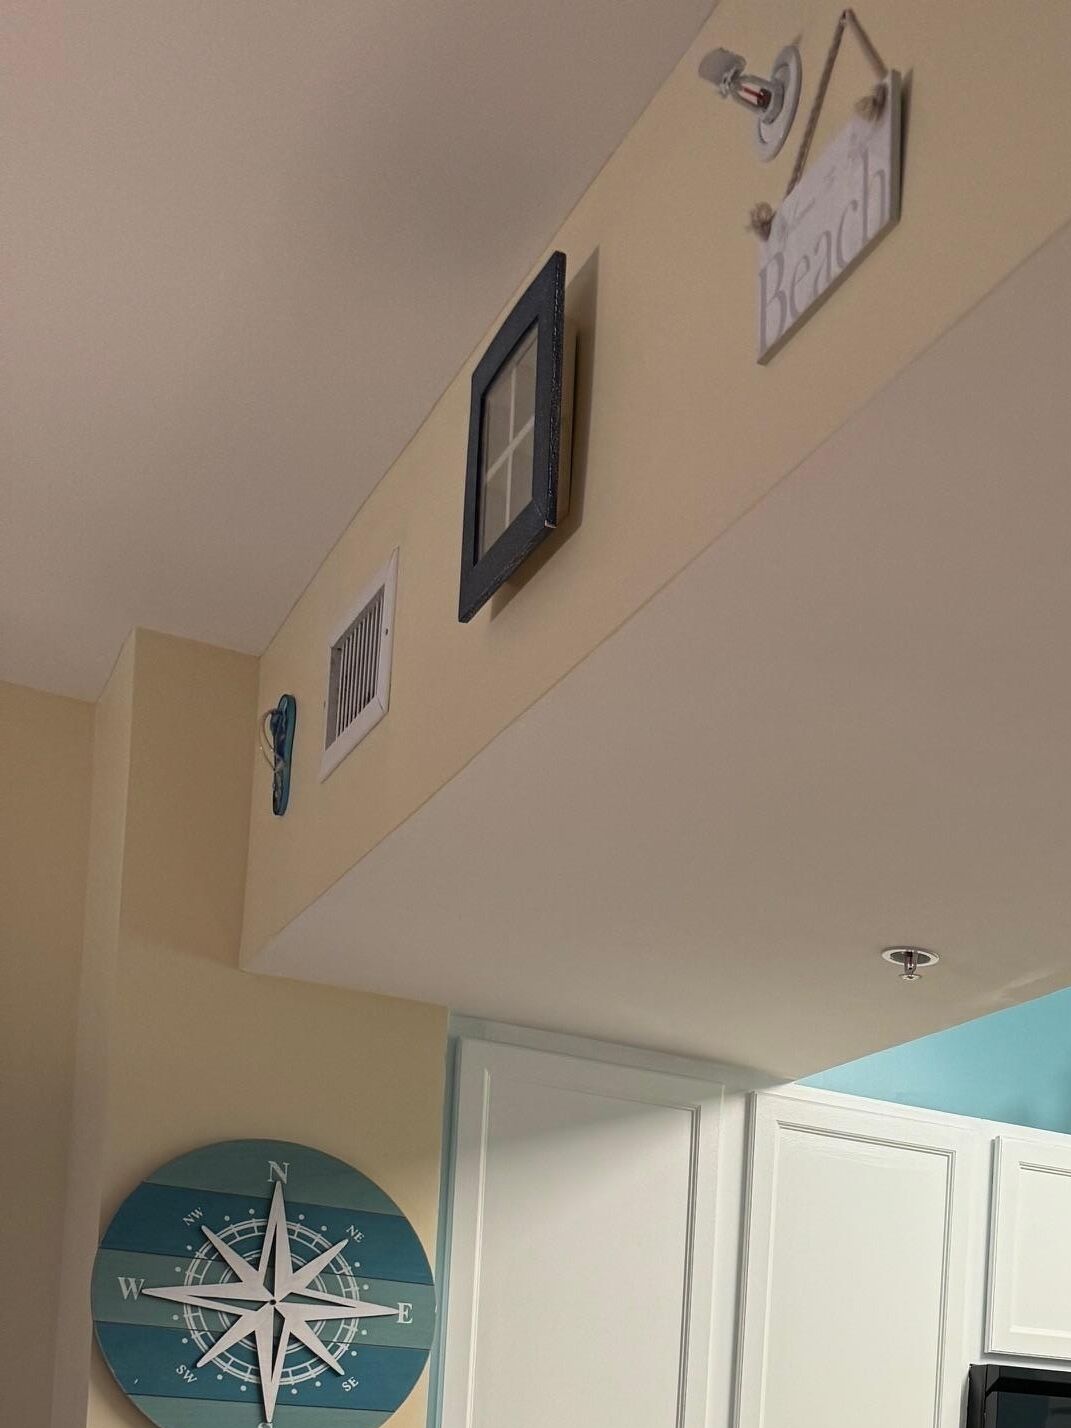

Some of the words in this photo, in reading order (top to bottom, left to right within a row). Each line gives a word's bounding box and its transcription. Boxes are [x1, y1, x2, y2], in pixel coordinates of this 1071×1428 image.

[758, 150, 886, 350] Beach
[267, 1160, 290, 1184] N
[182, 1206, 204, 1228] NW
[345, 1224, 365, 1245] NE
[117, 1276, 145, 1301] W
[397, 1302, 413, 1325] E
[175, 1363, 198, 1385] SW
[341, 1376, 359, 1393] SE
